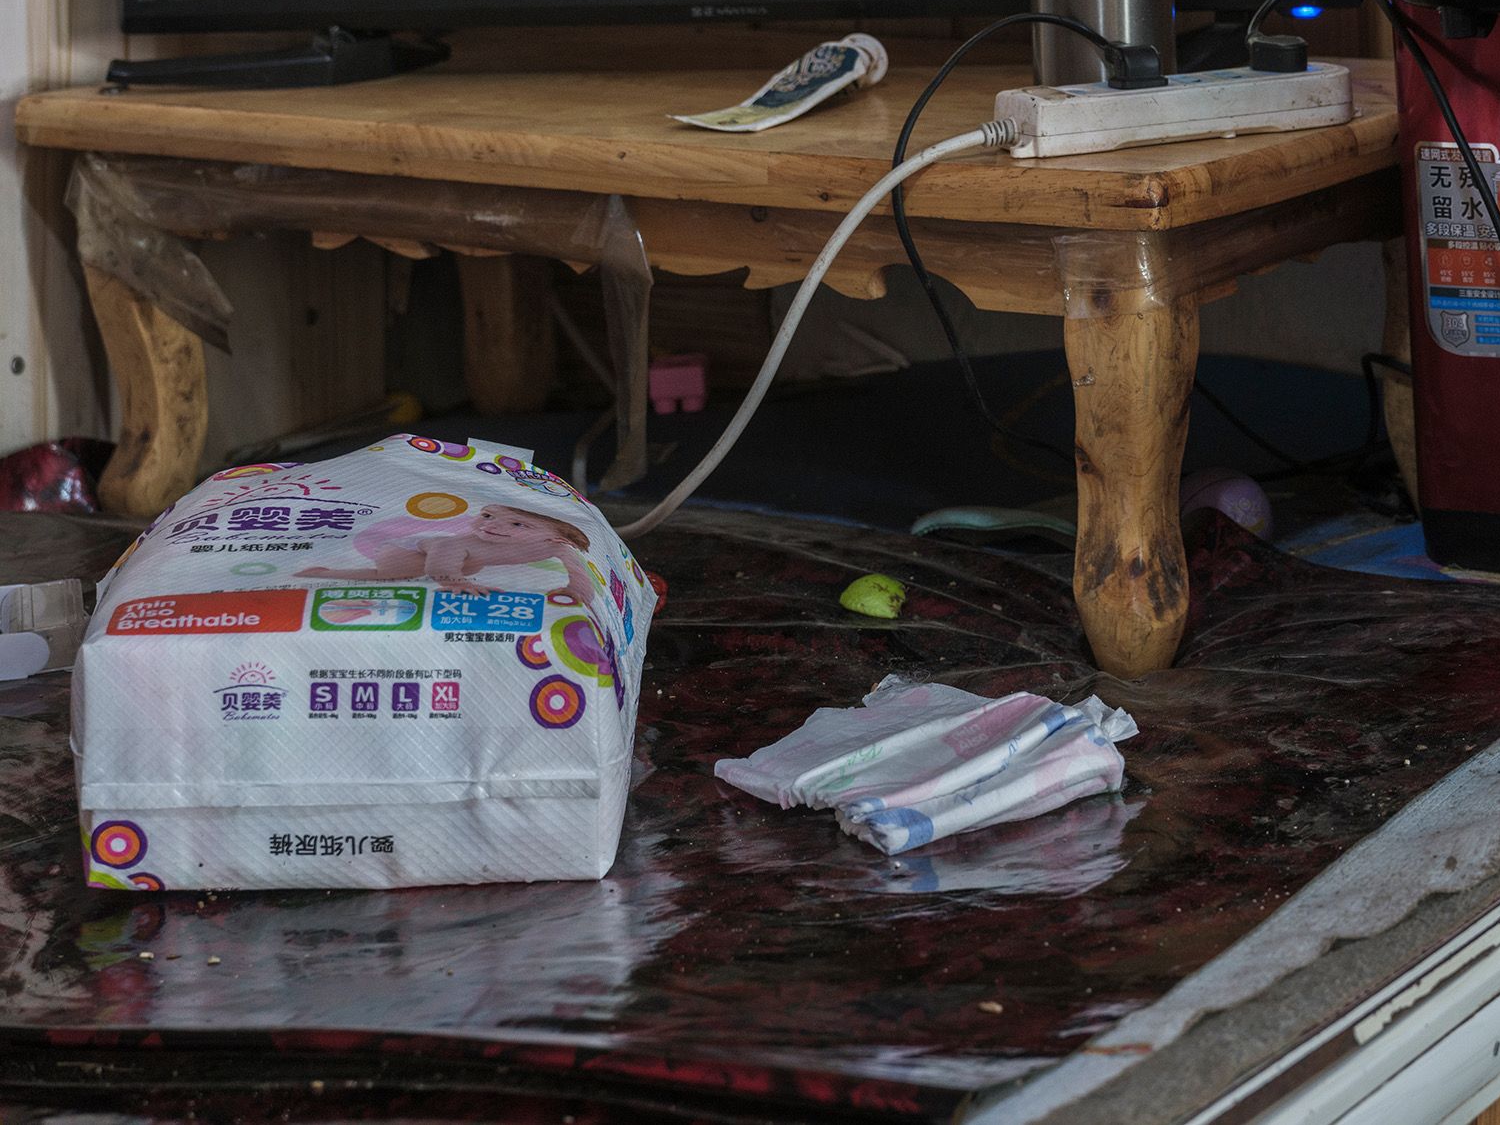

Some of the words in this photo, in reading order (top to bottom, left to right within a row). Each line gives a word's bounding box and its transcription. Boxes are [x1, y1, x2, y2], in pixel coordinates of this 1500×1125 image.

[1432, 195, 1484, 221] 留水
[1426, 222, 1476, 238] 多段保温
[170, 506, 355, 535] 贝婴美
[190, 541, 314, 554] 婴儿纸尿裤
[125, 600, 176, 613] Thin
[498, 595, 542, 605] DRY
[119, 608, 175, 621] Also
[437, 601, 478, 616] XL
[486, 604, 535, 620] 28
[117, 612, 261, 631] Breathable
[444, 632, 515, 643] 男女宝宝都适用
[220, 692, 282, 711] 贝婴美
[315, 686, 333, 703] S
[355, 686, 375, 703] M
[399, 686, 413, 703] L
[434, 686, 458, 702] XL
[269, 832, 394, 857] 婴儿纸尿裤
